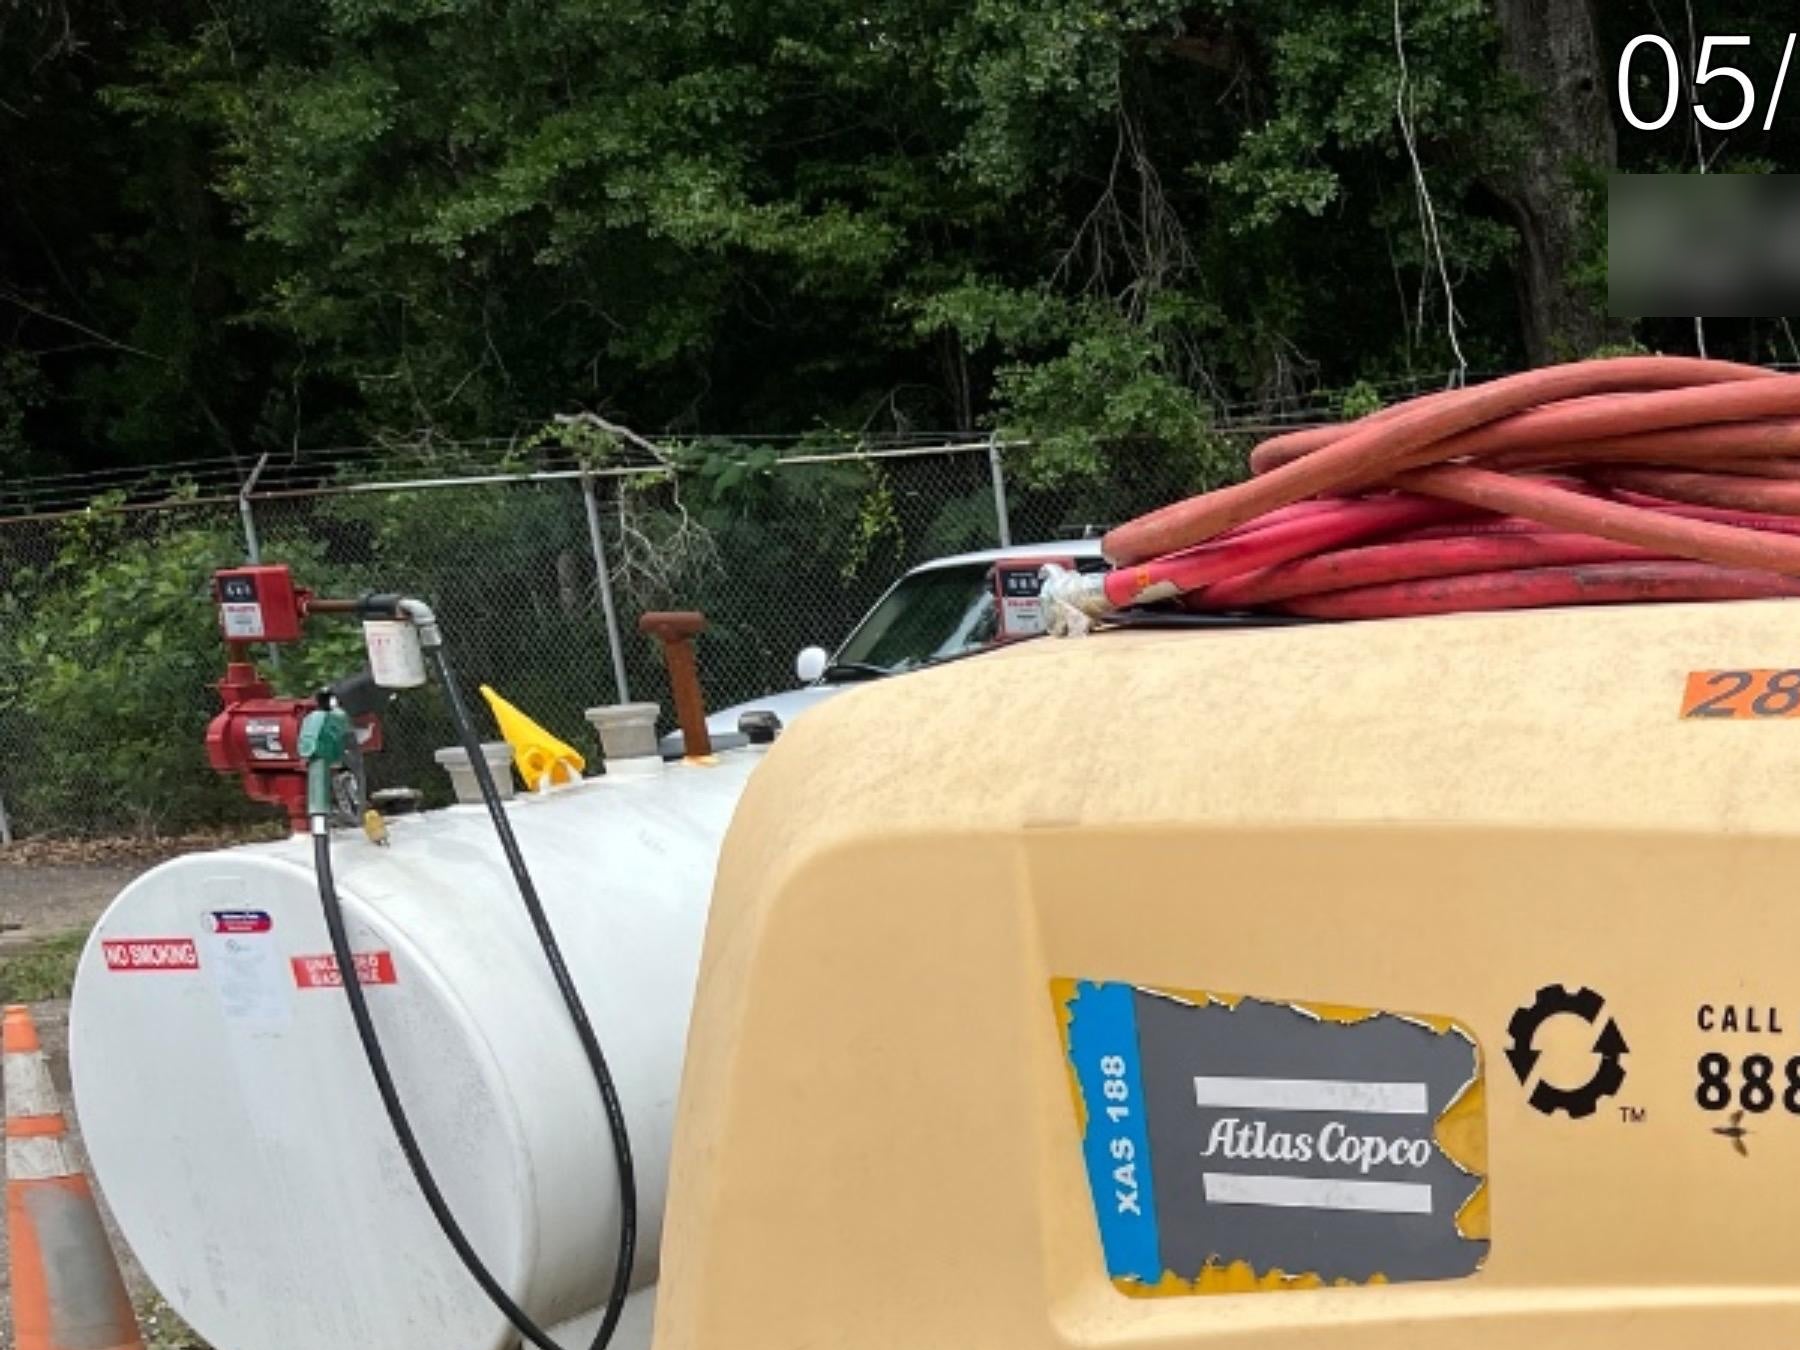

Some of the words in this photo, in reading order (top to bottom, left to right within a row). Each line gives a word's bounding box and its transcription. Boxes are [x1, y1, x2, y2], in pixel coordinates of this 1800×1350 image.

[103, 944, 129, 966] NO
[129, 943, 196, 966] SMOKING
[1697, 1004, 1783, 1034] CALL
[1100, 1055, 1129, 1122] 188
[1200, 1117, 1313, 1163] Atlas
[1317, 1121, 1433, 1175] Copco
[1110, 1136, 1141, 1217] XAS
